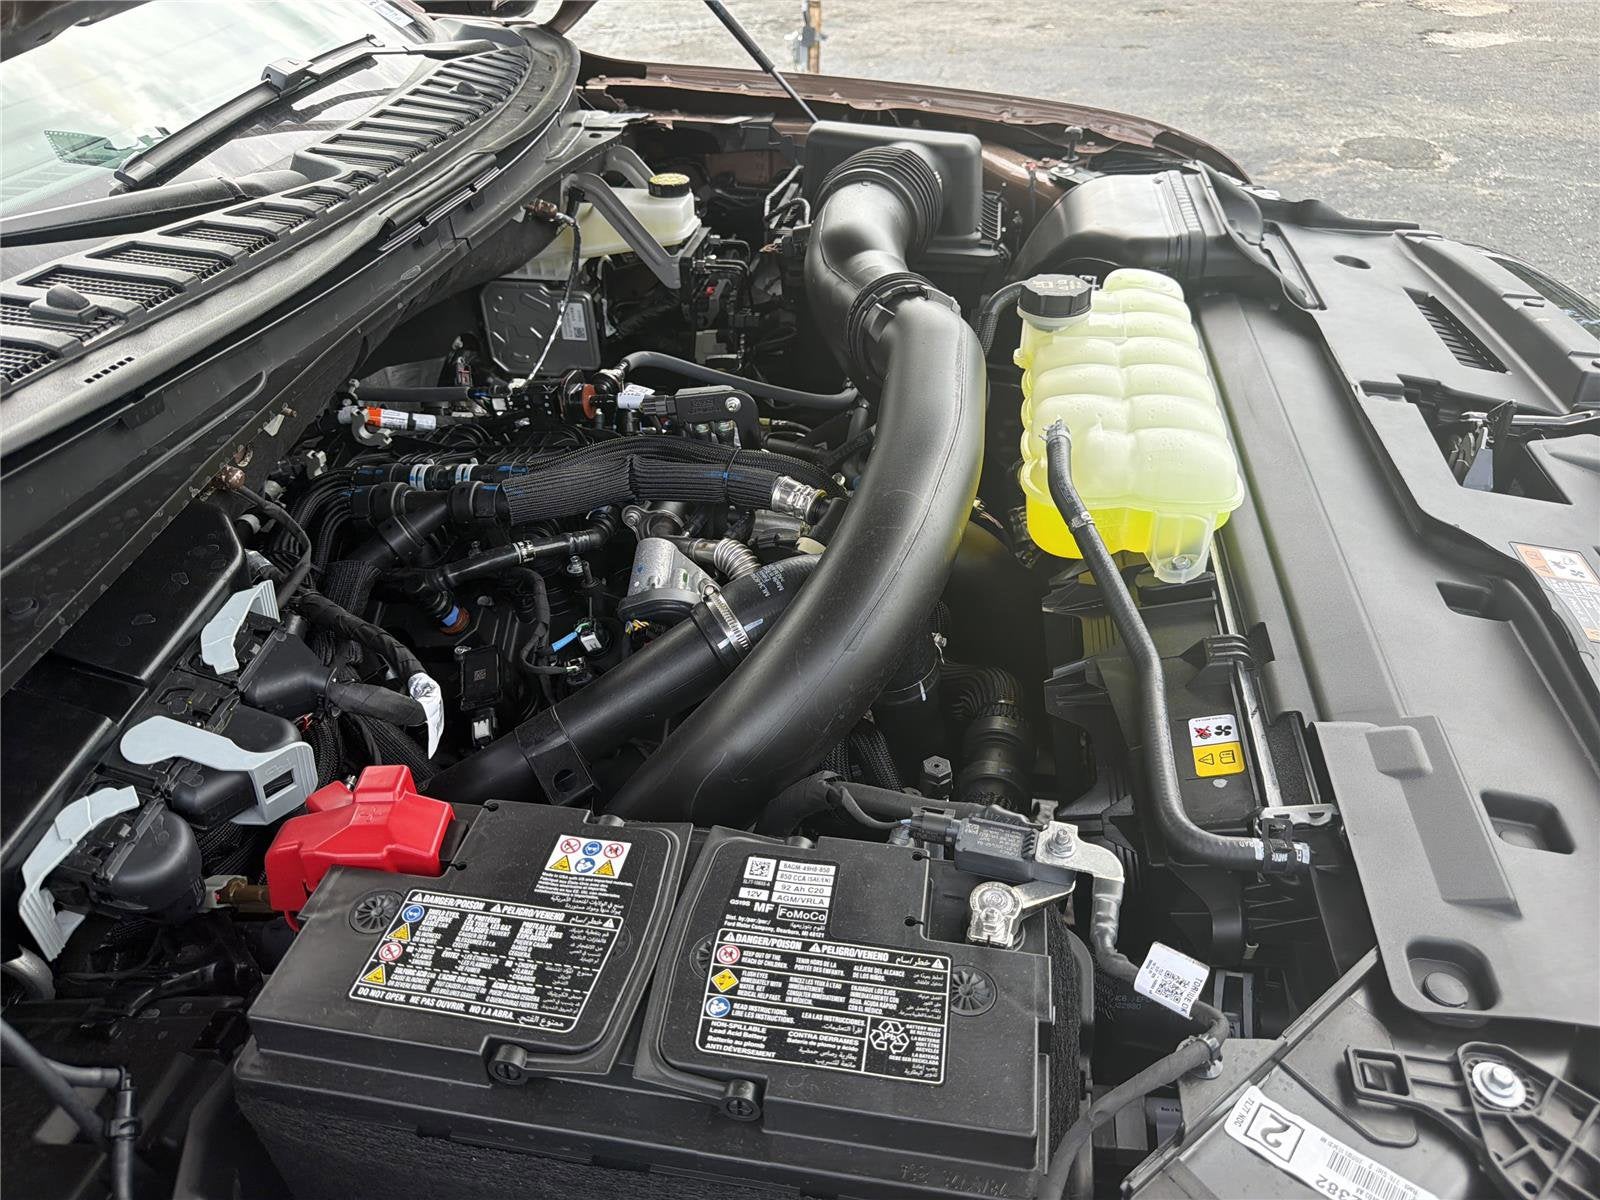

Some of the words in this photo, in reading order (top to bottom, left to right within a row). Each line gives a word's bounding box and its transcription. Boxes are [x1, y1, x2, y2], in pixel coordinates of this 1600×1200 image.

[421, 894, 486, 911] DANGER/POISON
[501, 905, 566, 921] PELIGRO/VENENO
[753, 902, 775, 913] MF
[776, 894, 825, 906] AGM/VRLA
[779, 907, 826, 922] FoMoCo
[735, 933, 803, 950] DANGER/POISON
[822, 944, 889, 962] PELIGRO/VENENO
[356, 987, 370, 996] DO
[368, 989, 386, 999] NOT
[384, 992, 409, 1002] OPEN.
[408, 995, 422, 1004] NE
[420, 997, 436, 1007] PAS
[435, 999, 468, 1011] OUVRIR.
[468, 1005, 482, 1014] NO
[480, 1007, 493, 1016] LA
[492, 1009, 518, 1019] ABRA.
[711, 1020, 767, 1034] NON-SPILLABLE
[707, 1035, 734, 1044] Batterie
[743, 1040, 766, 1050] plomb
[742, 1032, 768, 1042] Battery
[788, 1031, 818, 1040] CONTRA
[819, 1035, 859, 1046] DERRAMES
[1260, 1114, 1290, 1148] 2
